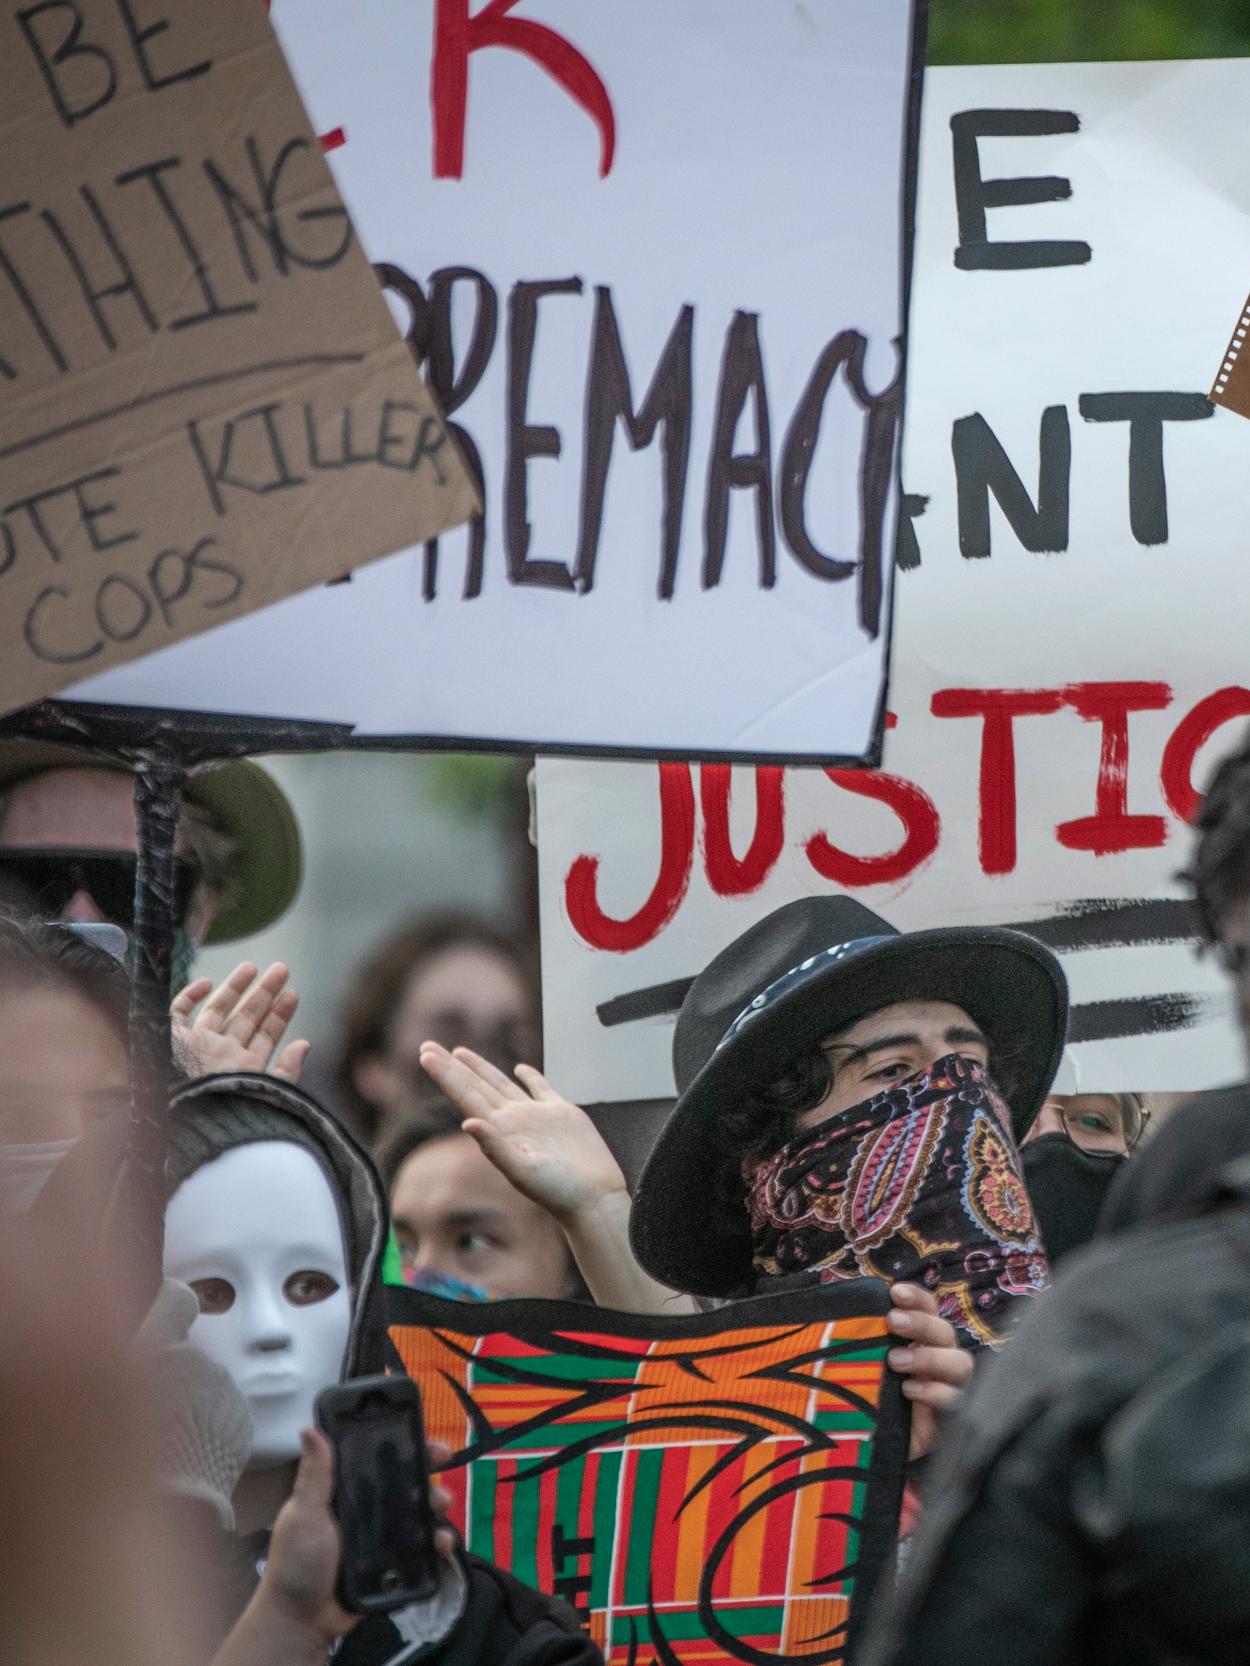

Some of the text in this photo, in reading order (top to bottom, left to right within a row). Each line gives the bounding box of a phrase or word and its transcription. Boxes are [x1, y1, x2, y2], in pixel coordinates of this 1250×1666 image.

[18, 0, 211, 128] BE
[0, 135, 352, 380] THING
[187, 400, 450, 518] KILLER
[23, 536, 244, 664] COPS
